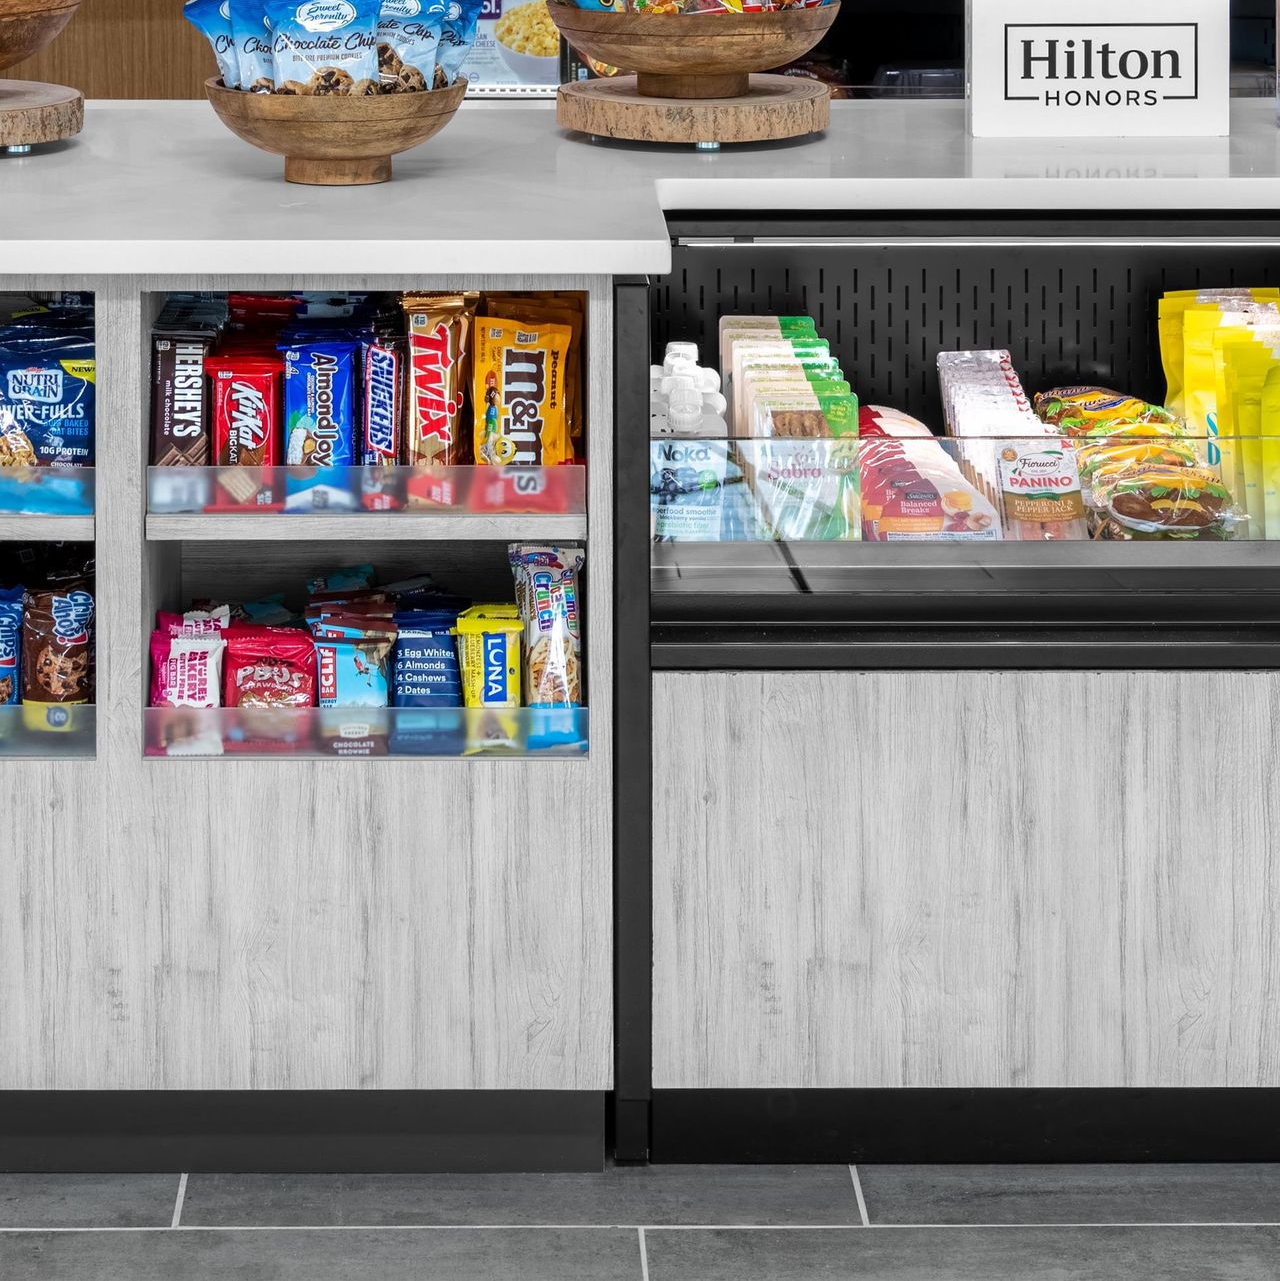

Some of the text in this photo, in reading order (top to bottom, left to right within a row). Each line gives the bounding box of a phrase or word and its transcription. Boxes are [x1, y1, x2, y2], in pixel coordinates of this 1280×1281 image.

[311, 1, 343, 13] Sweet
[274, 31, 376, 52] Chocolate Chip
[341, 52, 362, 60] COOKIES
[1020, 39, 1182, 80] Hilton
[1045, 90, 1157, 106] HONORS
[12, 374, 59, 386] NUTRI
[549, 349, 560, 410] Peanut
[12, 386, 58, 398] GRAIN
[172, 342, 204, 438] HERSHEY'S
[311, 352, 338, 429] Almond
[367, 347, 398, 453] SNICKERS
[162, 379, 173, 436] milk chocolate
[64, 419, 88, 427] BAKED
[51, 428, 88, 436] OAT BITES
[40, 446, 88, 456] 10G PROTEIN
[658, 444, 711, 463] Noka
[1019, 458, 1057, 469] Fiorucci
[1009, 476, 1072, 487] PANINO
[405, 649, 421, 658] Egg
[423, 649, 454, 657] Whites
[320, 648, 336, 686] CLIF
[397, 661, 445, 669] 6 Almonds
[487, 638, 503, 697] LUNA
[187, 652, 198, 701] BAKERY
[405, 674, 446, 682] Cashews
[405, 686, 431, 694] Dates
